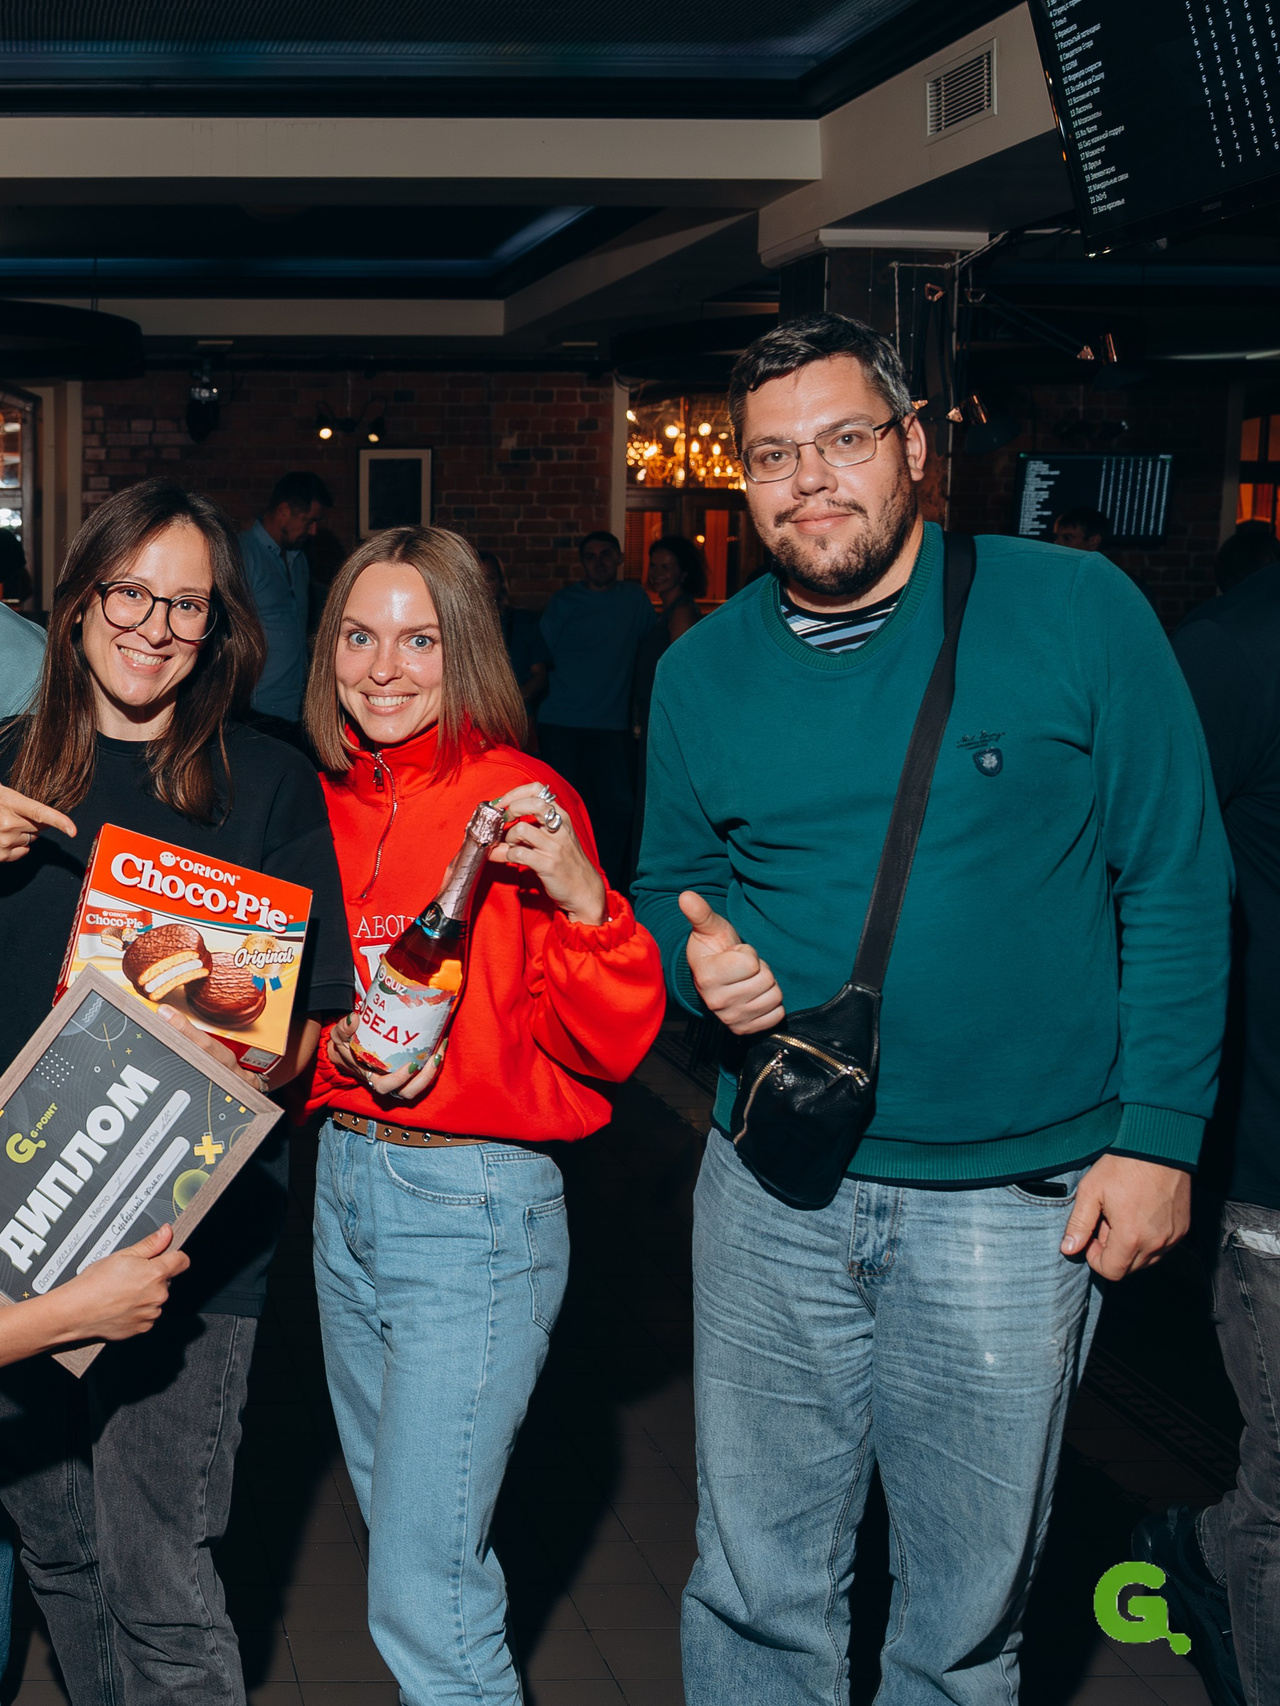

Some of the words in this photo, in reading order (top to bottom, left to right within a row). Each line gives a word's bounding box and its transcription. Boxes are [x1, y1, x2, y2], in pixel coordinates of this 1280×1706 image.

[179, 860, 237, 886] ORION
[234, 946, 294, 968] Original
[372, 993, 386, 1012] ЗА
[360, 1004, 420, 1047] БЕДУ
[88, 1195, 111, 1221] Место
[38, 1268, 55, 1289] Дата
